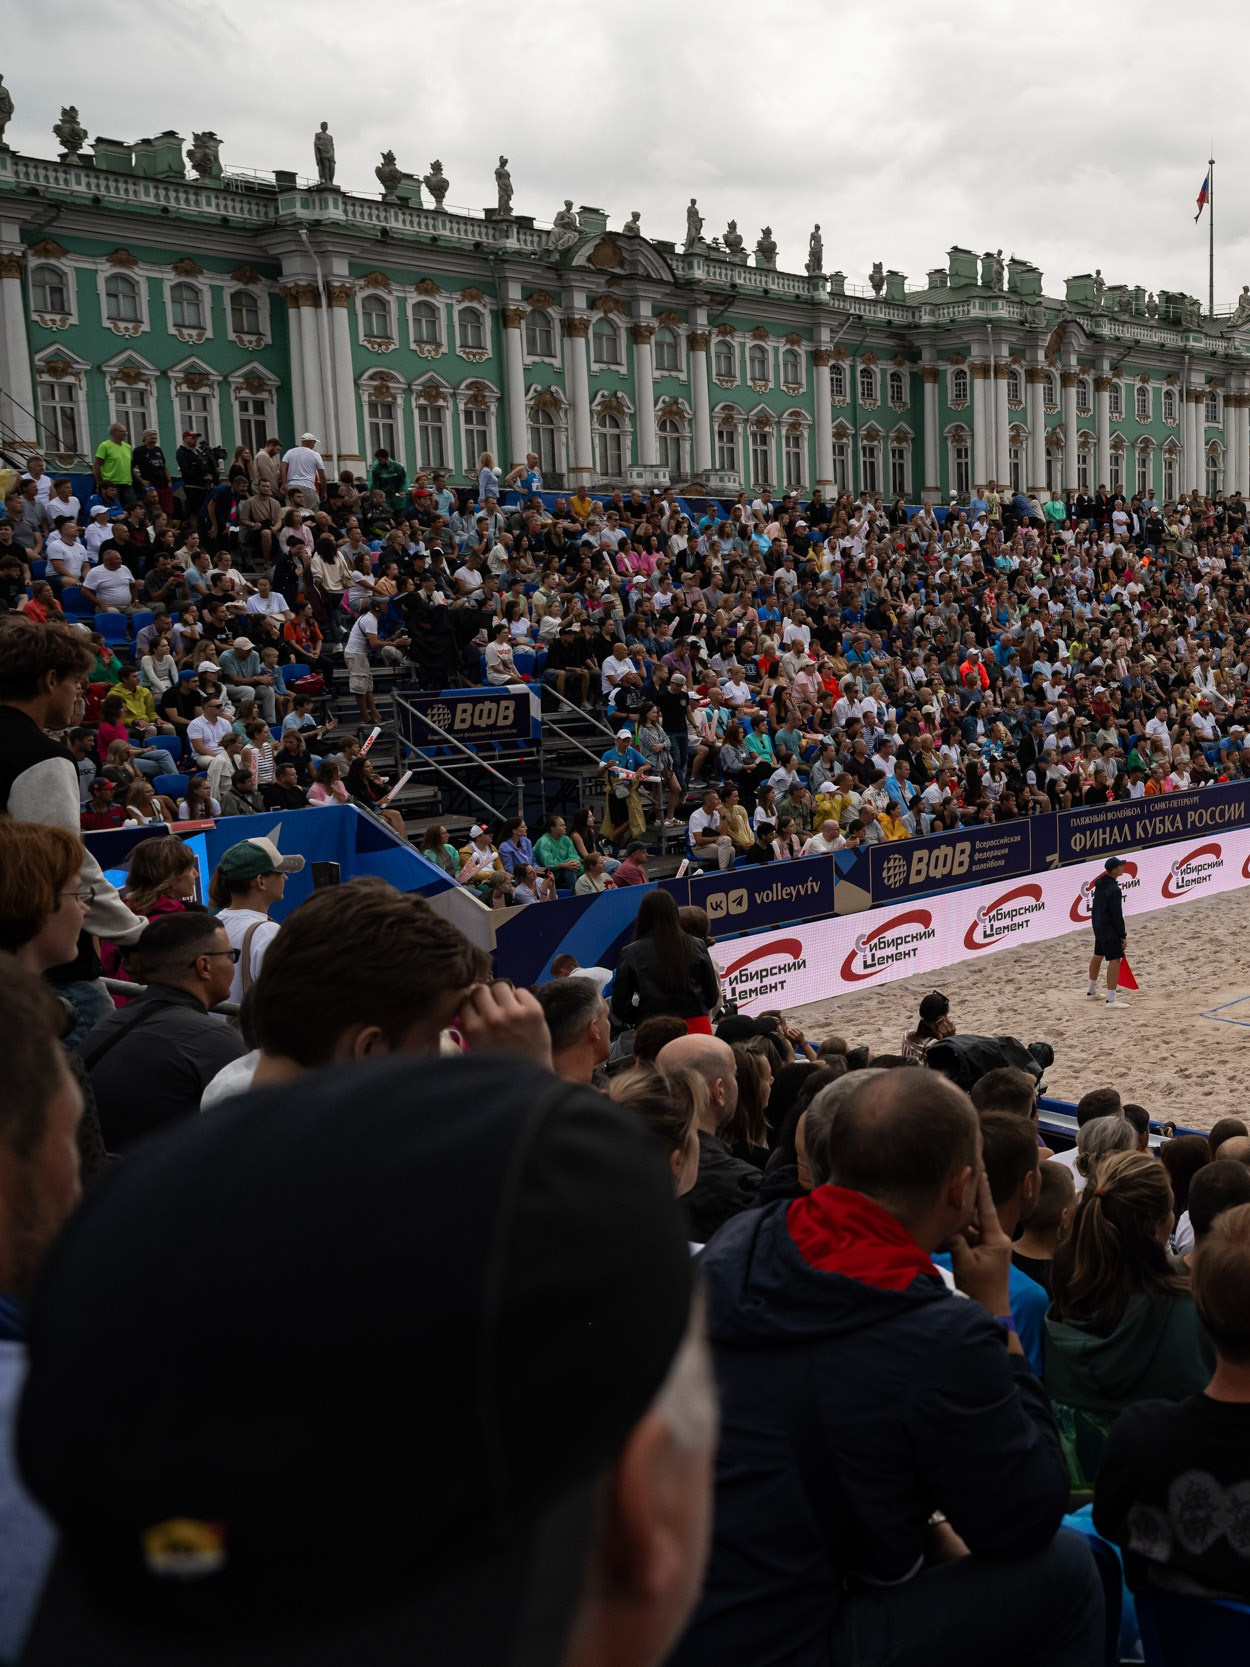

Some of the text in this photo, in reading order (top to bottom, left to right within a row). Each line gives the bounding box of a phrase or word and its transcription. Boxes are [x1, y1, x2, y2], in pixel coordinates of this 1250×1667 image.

[453, 700, 516, 730] ВФВ
[1070, 796, 1200, 828] ПЛЯЖНЫЙ ВОЛЕЙБОЛ САНКТ-ПЕТЕРБУРГ
[1070, 801, 1246, 852] ФИНАЛ КУБКА РОССИИ
[975, 834, 1021, 850] Всероссийская
[908, 842, 972, 884] ВФВ
[972, 858, 1004, 872] волейбола
[973, 848, 1009, 862] федерация
[1171, 858, 1224, 878] Сибирский
[754, 876, 821, 904] volleyvfv
[1176, 874, 1212, 890] Цемент
[976, 900, 1045, 924] Сибирский
[982, 919, 1030, 939] Цемент
[855, 928, 936, 954] Сибирский
[862, 947, 918, 970] Цемент
[722, 980, 787, 1003] Цемент
